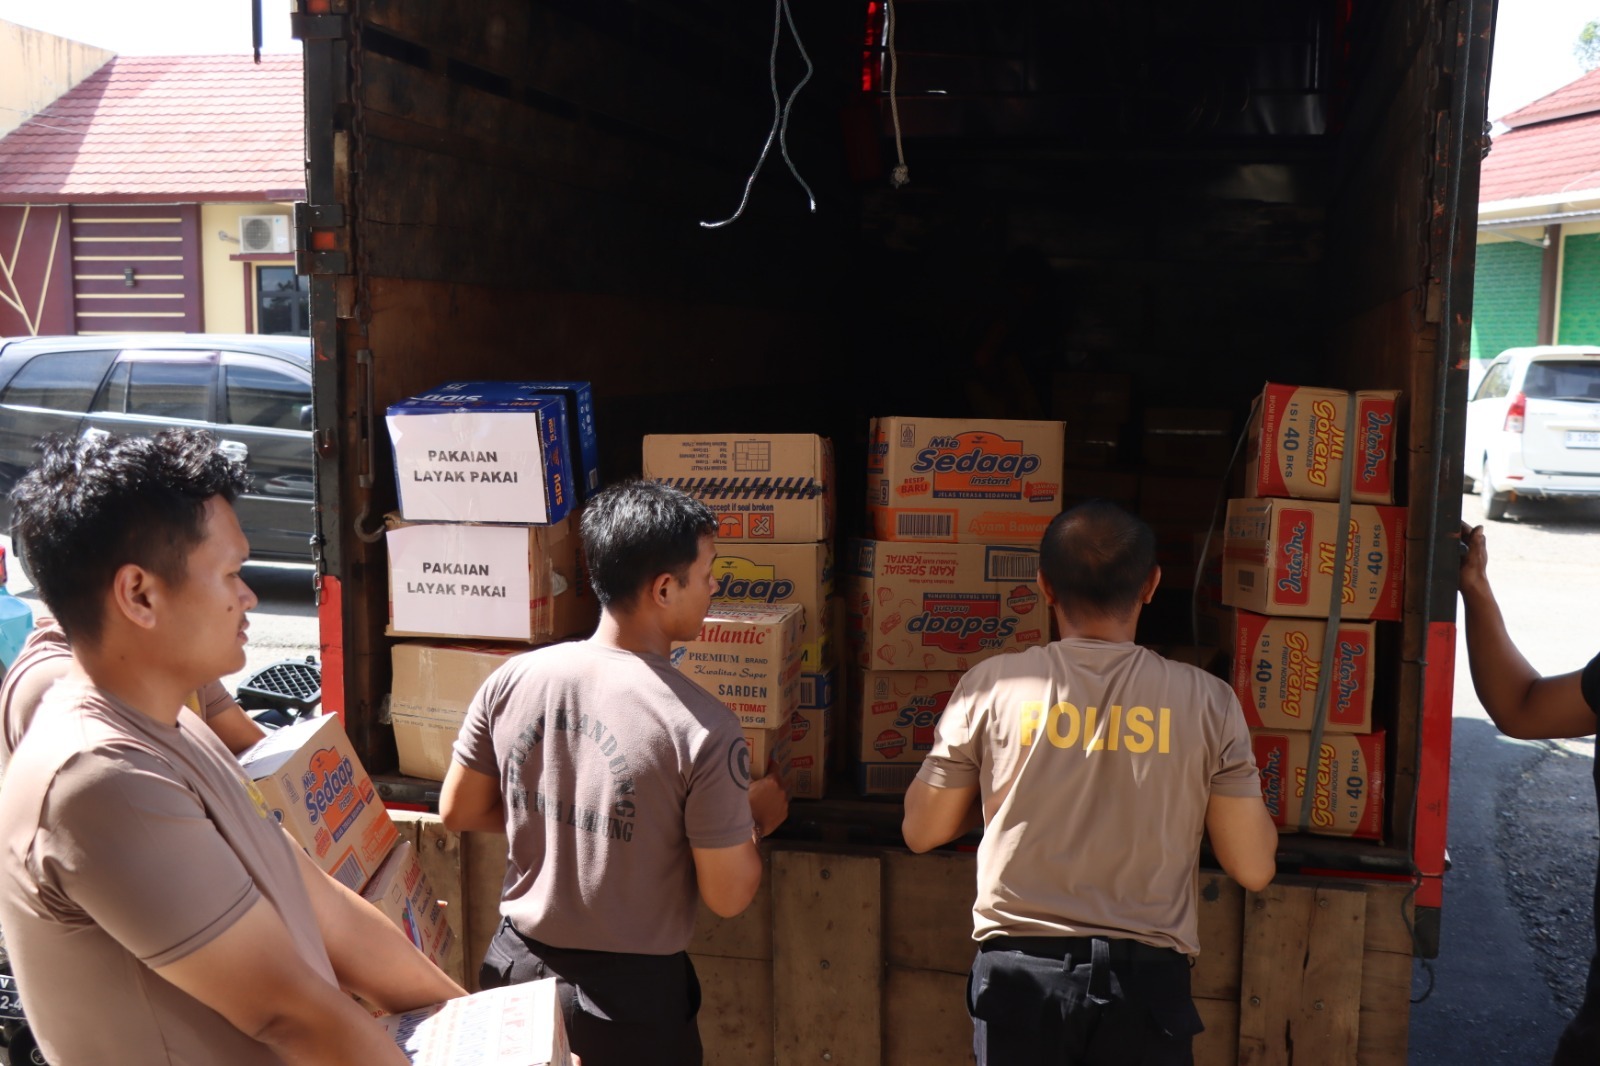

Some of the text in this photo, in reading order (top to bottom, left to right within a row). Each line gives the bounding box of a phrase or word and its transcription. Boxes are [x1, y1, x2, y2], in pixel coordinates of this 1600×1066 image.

[929, 436, 960, 449] Mie
[1283, 403, 1300, 478] ISI 40 BKS
[1306, 415, 1316, 468] FRIED NOODLES
[1308, 400, 1336, 487] Goreng
[427, 450, 498, 463] PAKAIAN
[911, 448, 1041, 479] Sedaap
[414, 470, 518, 484] LAYAK PAKAI
[969, 475, 1011, 486] Instant
[901, 484, 928, 493] BARU
[968, 519, 1005, 536] Ayam
[422, 562, 489, 576] PAKAIAN
[886, 555, 922, 565] KENTAL
[1351, 534, 1361, 588] FRIED NOODLES
[1367, 524, 1383, 600] ISI 40 BKS
[883, 565, 955, 576] KARI SPESIAL
[407, 582, 506, 597] LAYAK PAKAI
[698, 625, 765, 645] Atlantic
[905, 612, 1019, 639] Sedaap
[979, 638, 1004, 649] Mie
[688, 652, 739, 664] PREMIUM
[694, 665, 768, 679] Kwalitas Super
[1256, 634, 1273, 709] ISI 40 BKS
[1282, 631, 1309, 718] Goreng
[718, 684, 767, 698] SARDEN
[1279, 667, 1287, 699] NOODLES
[738, 703, 766, 713] TOMAT
[1020, 700, 1171, 754] POLISI
[302, 771, 317, 791] Mie
[305, 755, 354, 825] Sedaap
[1347, 776, 1363, 799] 40
[1349, 805, 1358, 824] ISI
